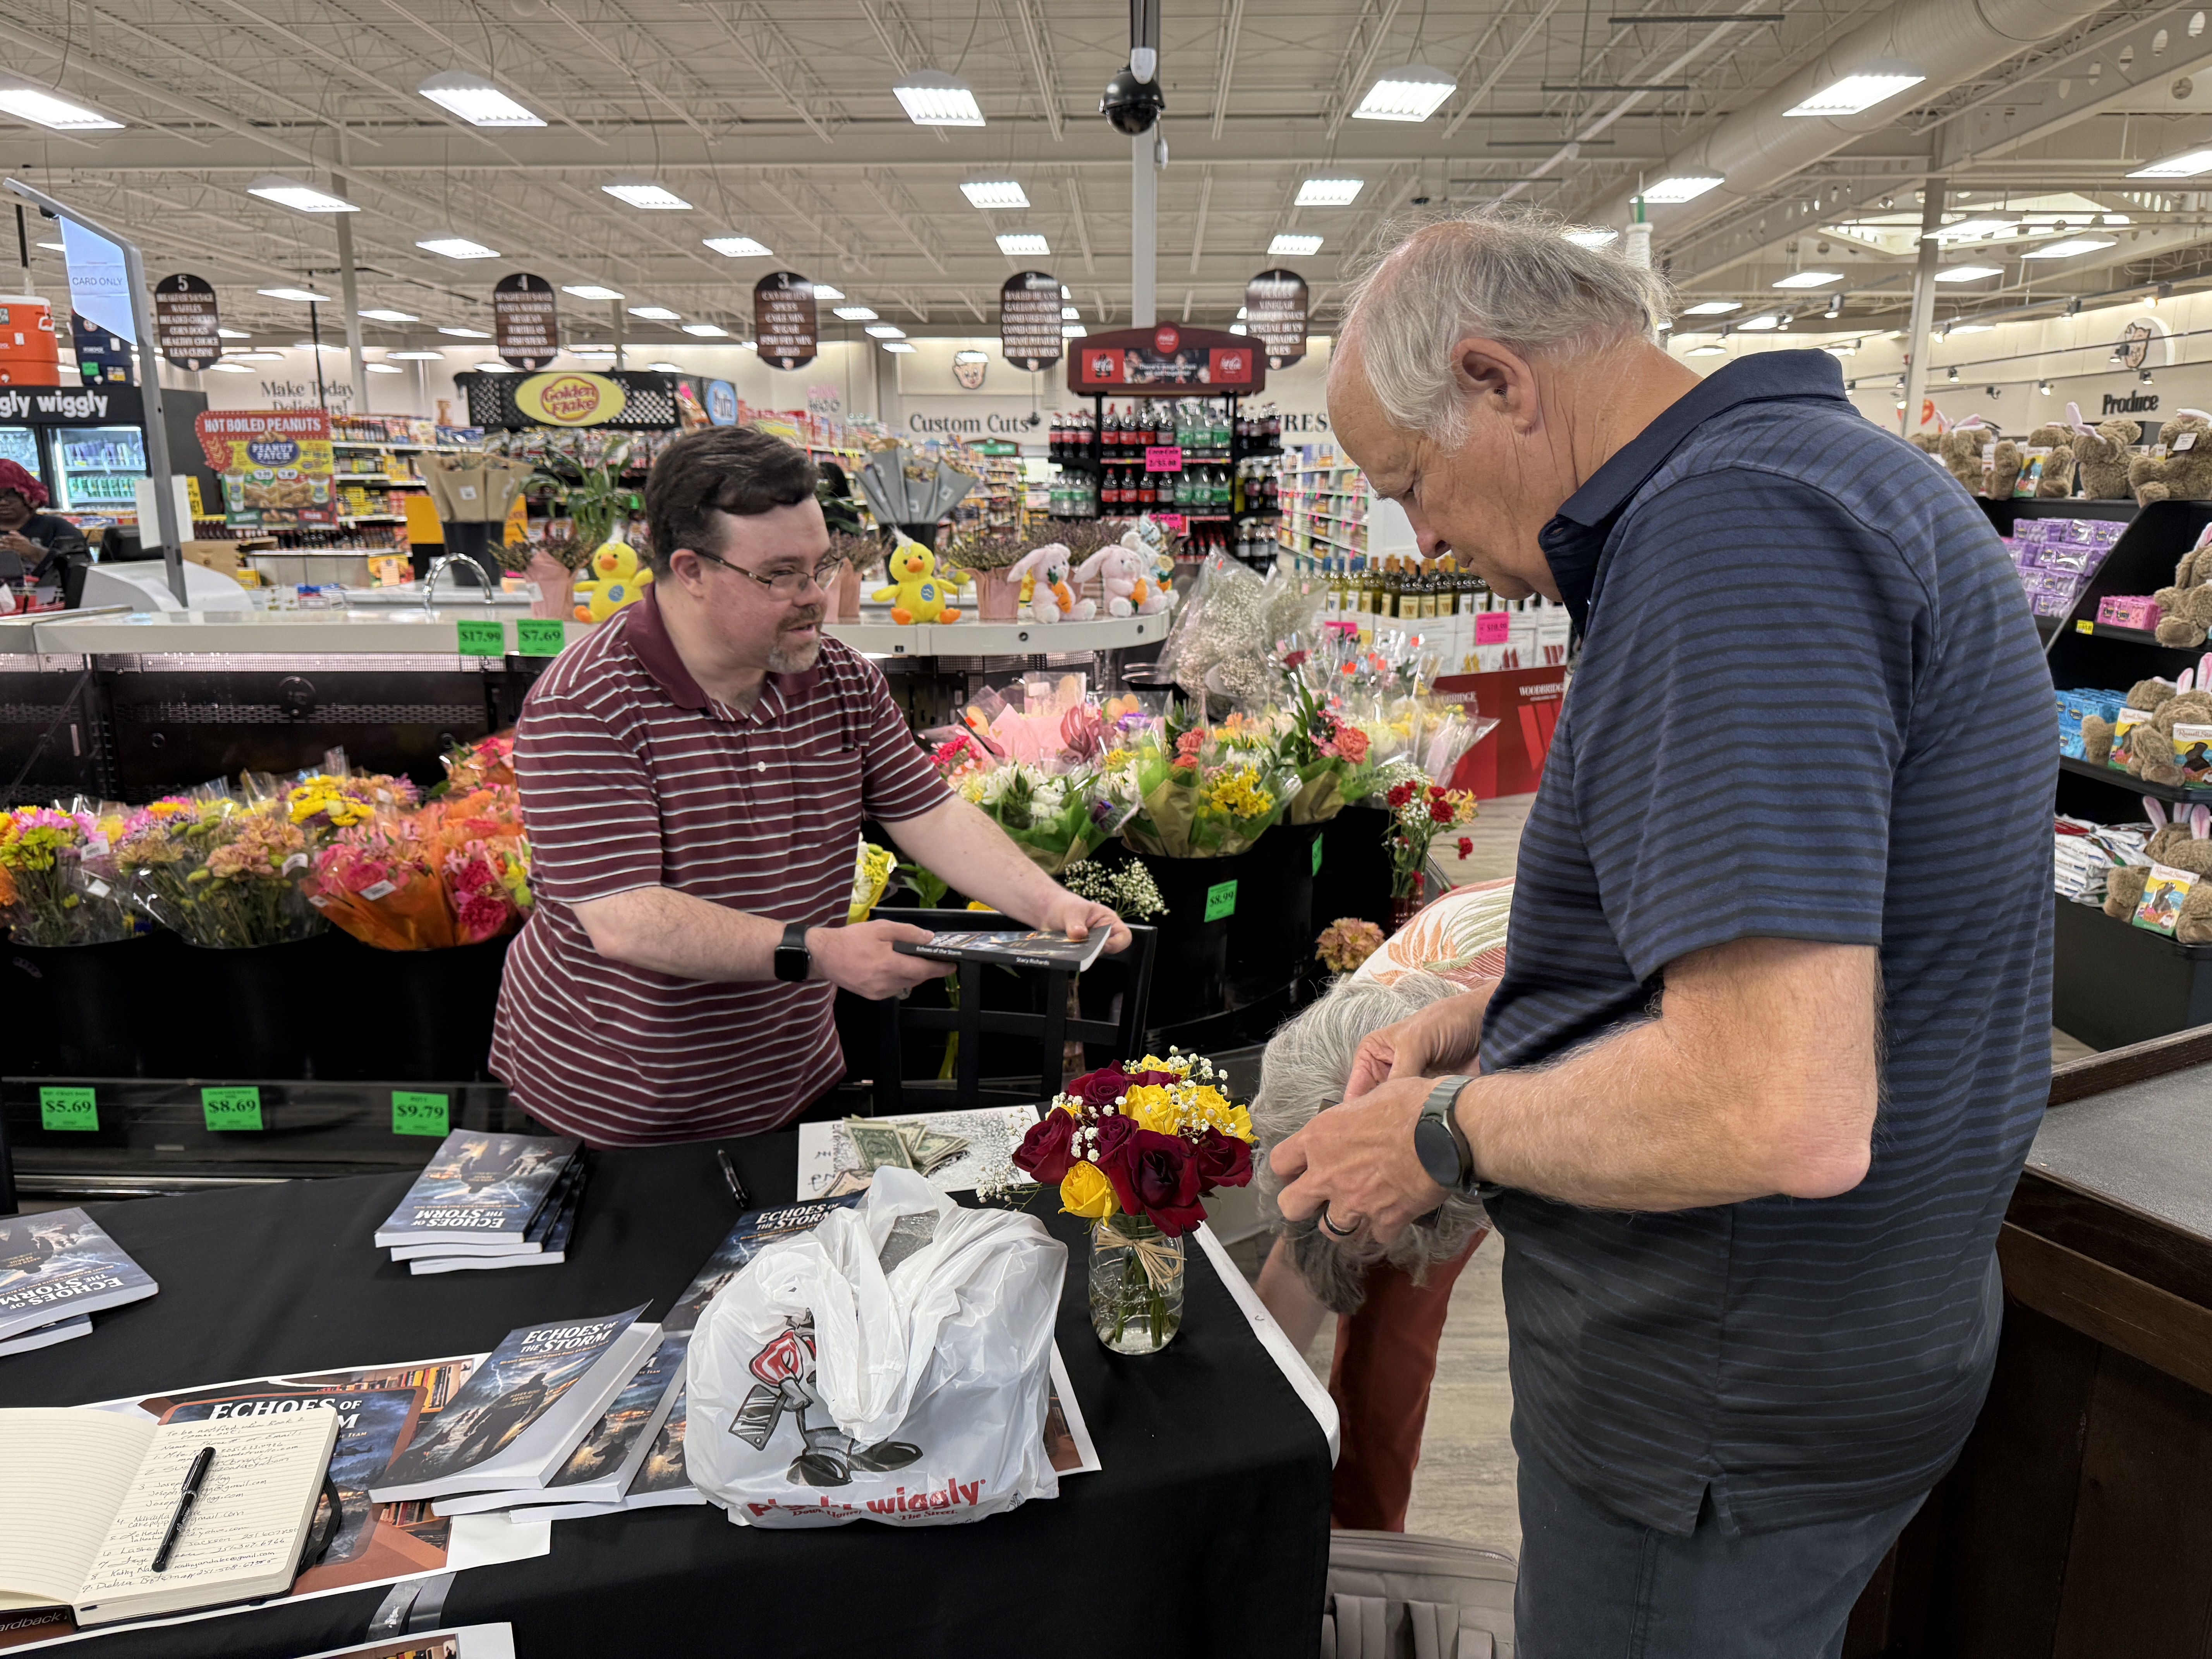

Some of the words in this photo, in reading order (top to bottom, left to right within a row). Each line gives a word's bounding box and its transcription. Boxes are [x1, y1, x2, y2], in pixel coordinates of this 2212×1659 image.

[72, 277, 97, 286] CARD
[99, 277, 122, 286] ONLY
[177, 274, 189, 291] 5
[517, 274, 528, 290] 4
[778, 273, 789, 290] 3
[170, 304, 203, 313] WAFFLES
[1259, 299, 1295, 309] VINEGAR
[261, 380, 305, 397] Make
[545, 385, 595, 402] Golden
[0, 390, 31, 418] gly
[36, 390, 108, 418] wiggly
[553, 398, 595, 415] Flake
[2102, 390, 2159, 416] Produce
[204, 418, 225, 433] HOT
[226, 417, 265, 432] BOILED
[266, 417, 321, 432] PEANUTS
[910, 413, 981, 433] Custom
[988, 413, 1030, 433] Cuts
[1283, 413, 1328, 433] RES
[251, 443, 294, 453] PEANUT
[256, 452, 290, 460] PATCH
[461, 630, 501, 642] $17.99
[521, 630, 561, 642] $7.69
[2177, 728, 2200, 737] Russell
[1209, 891, 1234, 907] $8.99
[1016, 956, 1029, 964] Stacy
[45, 1100, 91, 1114] $5.69
[208, 1099, 256, 1114] $8.69
[397, 1105, 444, 1119] $9.79
[415, 1209, 484, 1219] STORM
[756, 1203, 827, 1224] ECHOES
[427, 1218, 506, 1228] ECHOES
[84, 1273, 108, 1283] THE
[0, 1278, 83, 1305] STORM
[28, 1277, 124, 1306] ECHOES
[9, 1301, 26, 1310] OF
[520, 1324, 604, 1345] ECHOES
[603, 1321, 619, 1330] OF
[520, 1344, 542, 1353] THE
[539, 1329, 613, 1353] STORM
[339, 1400, 362, 1410] OF
[198, 1425, 237, 1434] notified
[242, 1421, 264, 1429] when
[165, 1451, 186, 1459] Mike
[866, 1477, 979, 1515] wiggly
[899, 1511, 922, 1521] The
[924, 1508, 958, 1518] Street.
[185, 1538, 231, 1546] Jackson
[110, 1568, 134, 1577] Kathy
[0, 1612, 62, 1632] ardback
